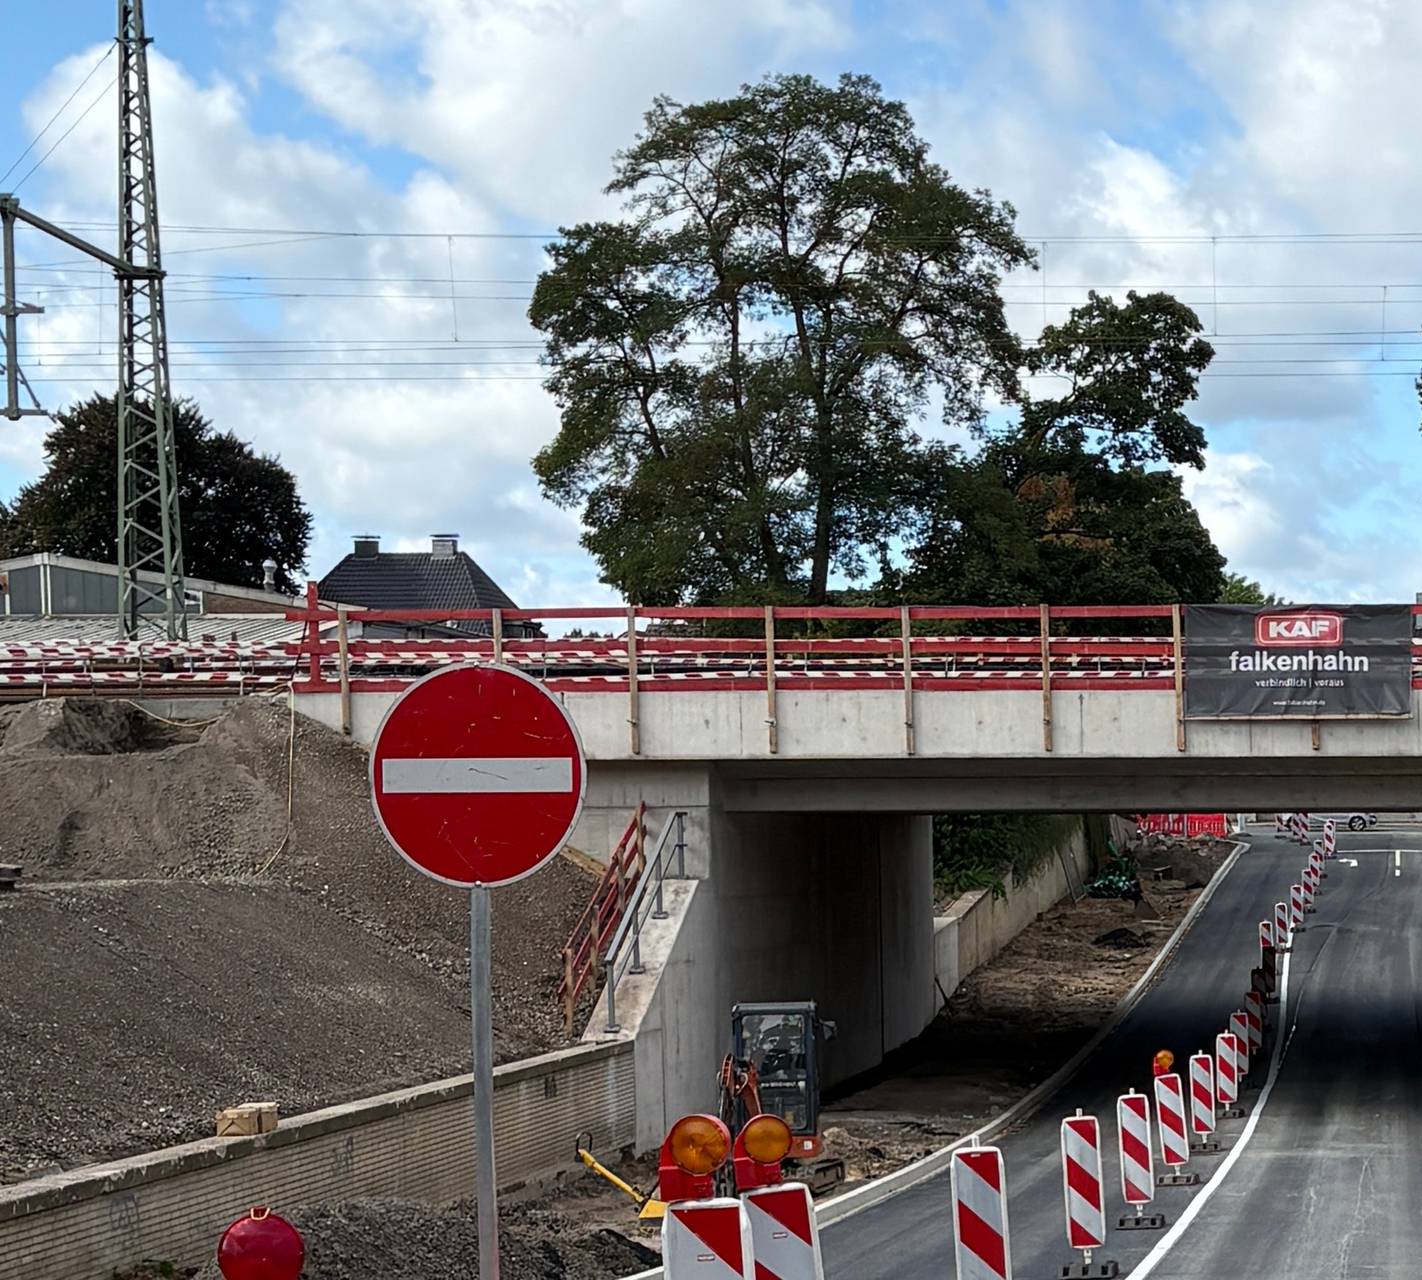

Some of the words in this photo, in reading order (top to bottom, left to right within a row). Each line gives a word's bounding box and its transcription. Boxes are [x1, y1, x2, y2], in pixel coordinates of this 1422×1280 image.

[1268, 620, 1330, 638] KAF
[1229, 650, 1369, 672] falkenhahn
[1255, 677, 1307, 688] verbindlich
[1314, 678, 1345, 688] voraus
